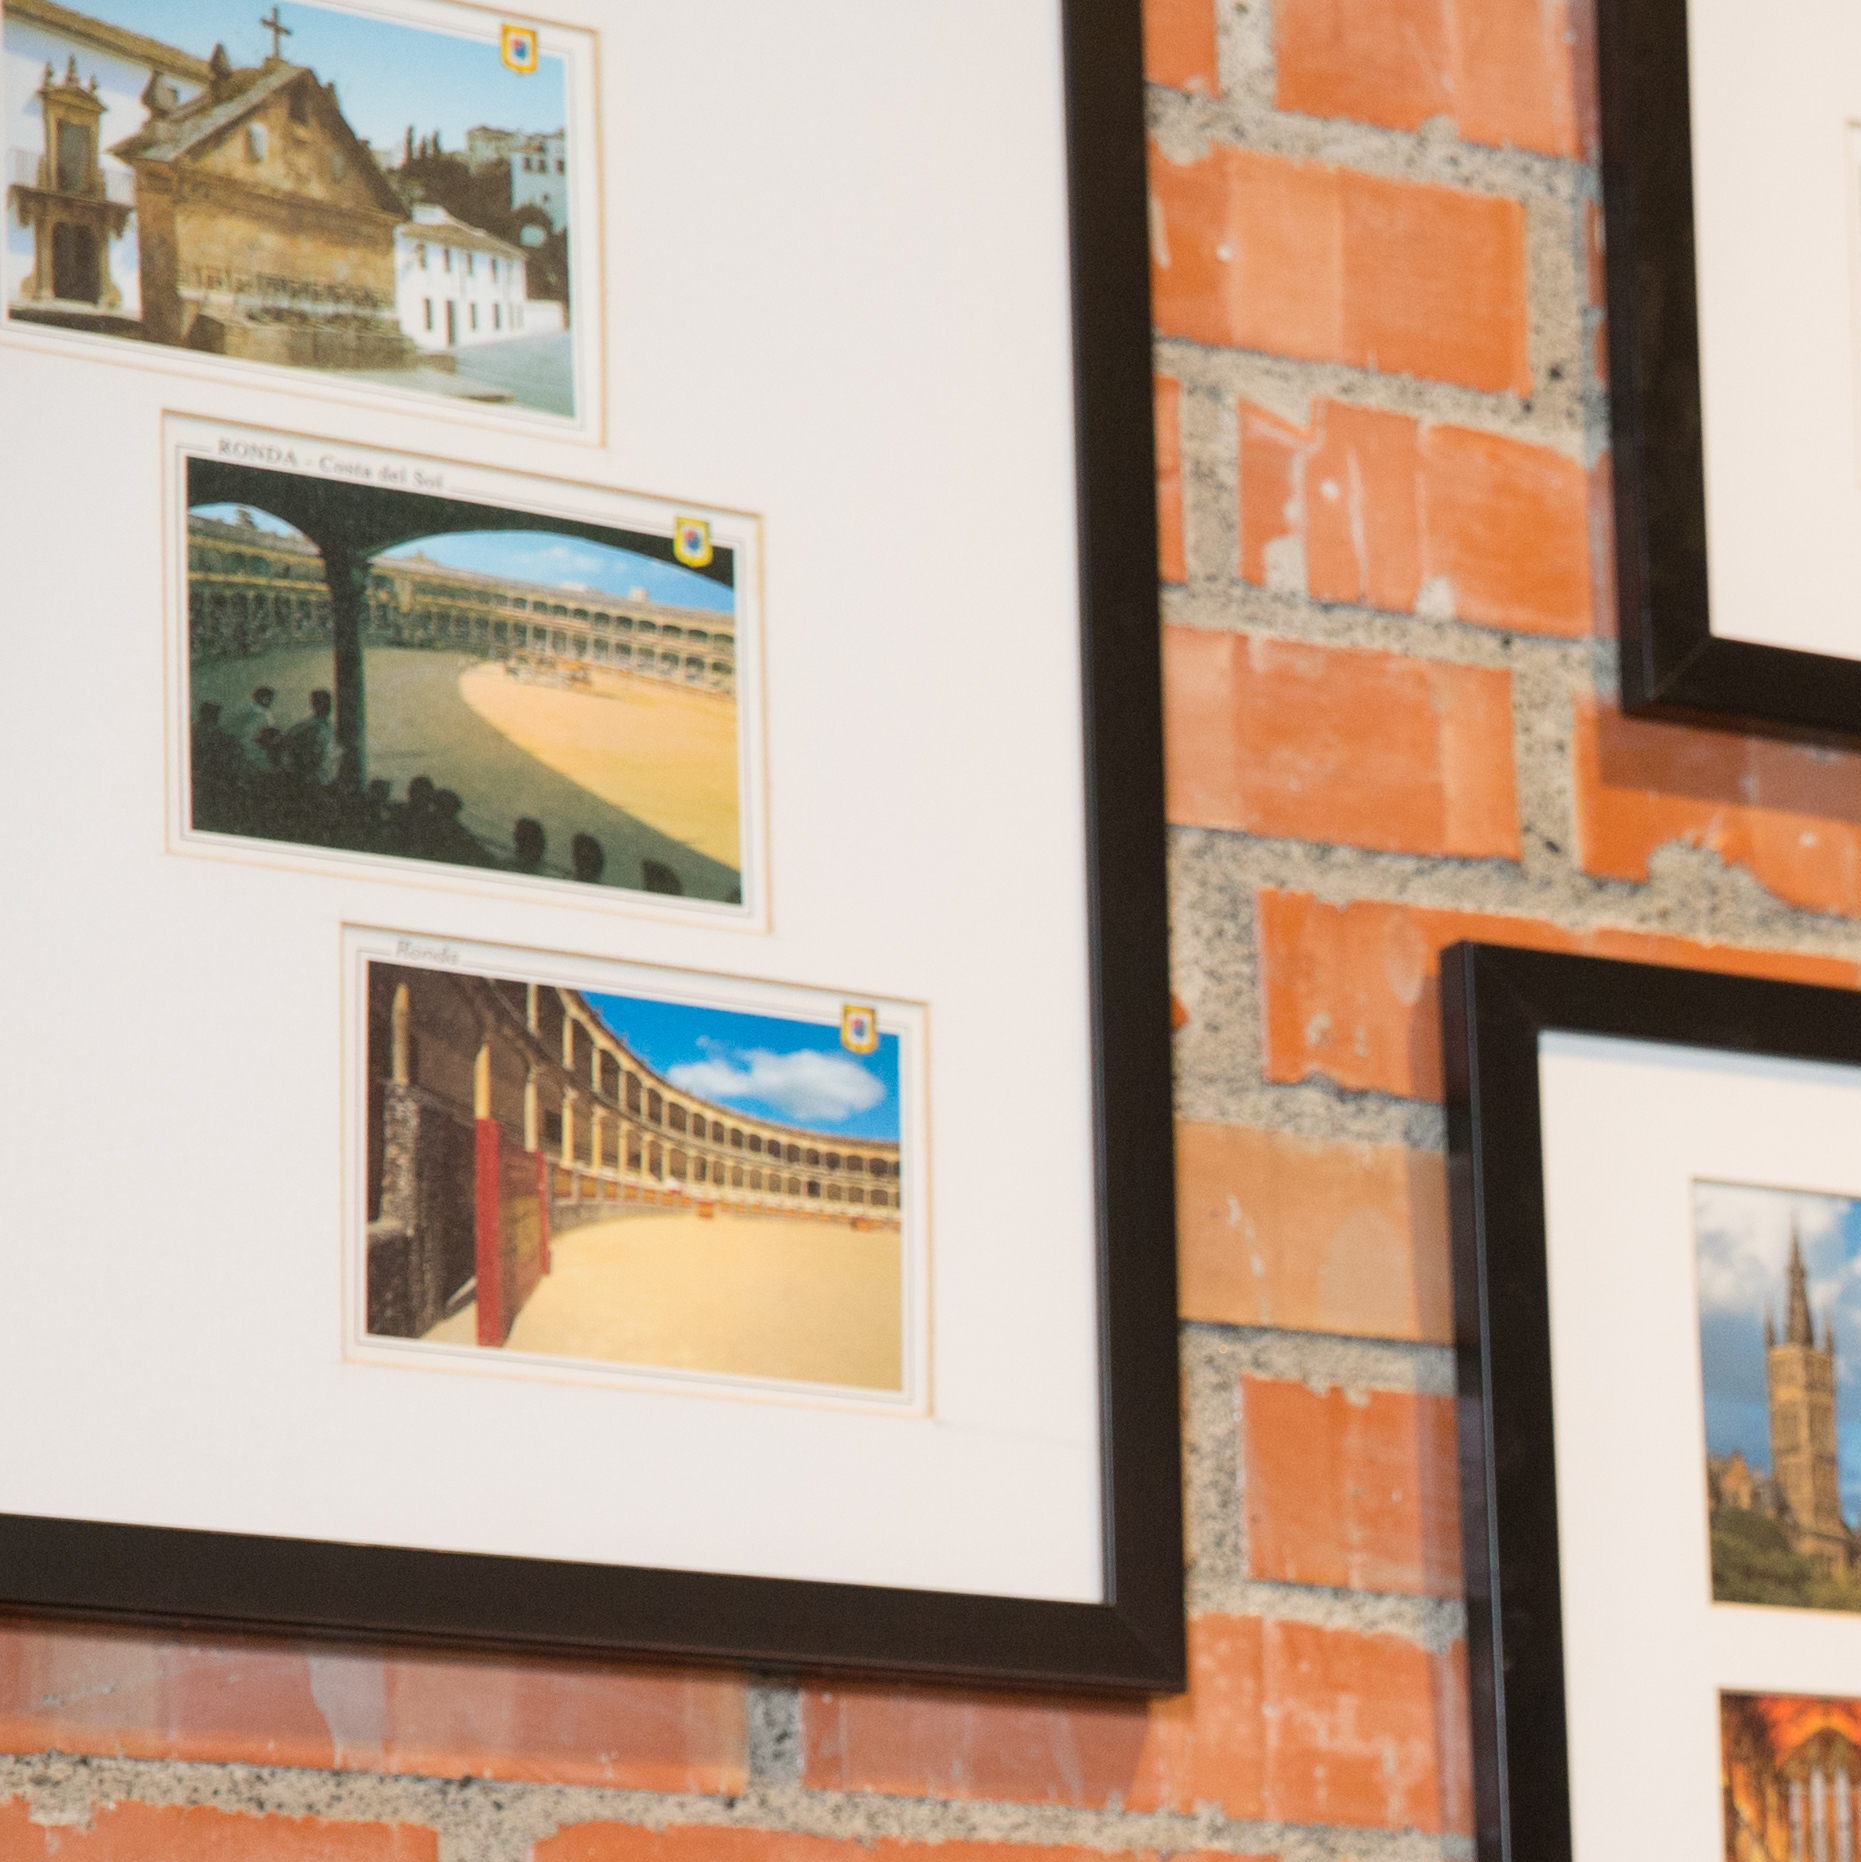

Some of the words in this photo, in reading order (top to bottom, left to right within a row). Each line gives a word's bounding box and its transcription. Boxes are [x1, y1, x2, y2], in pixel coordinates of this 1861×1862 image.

[217, 436, 298, 468] RONDA
[318, 454, 374, 480] Costa
[378, 464, 408, 486] del
[412, 469, 444, 490] Sol
